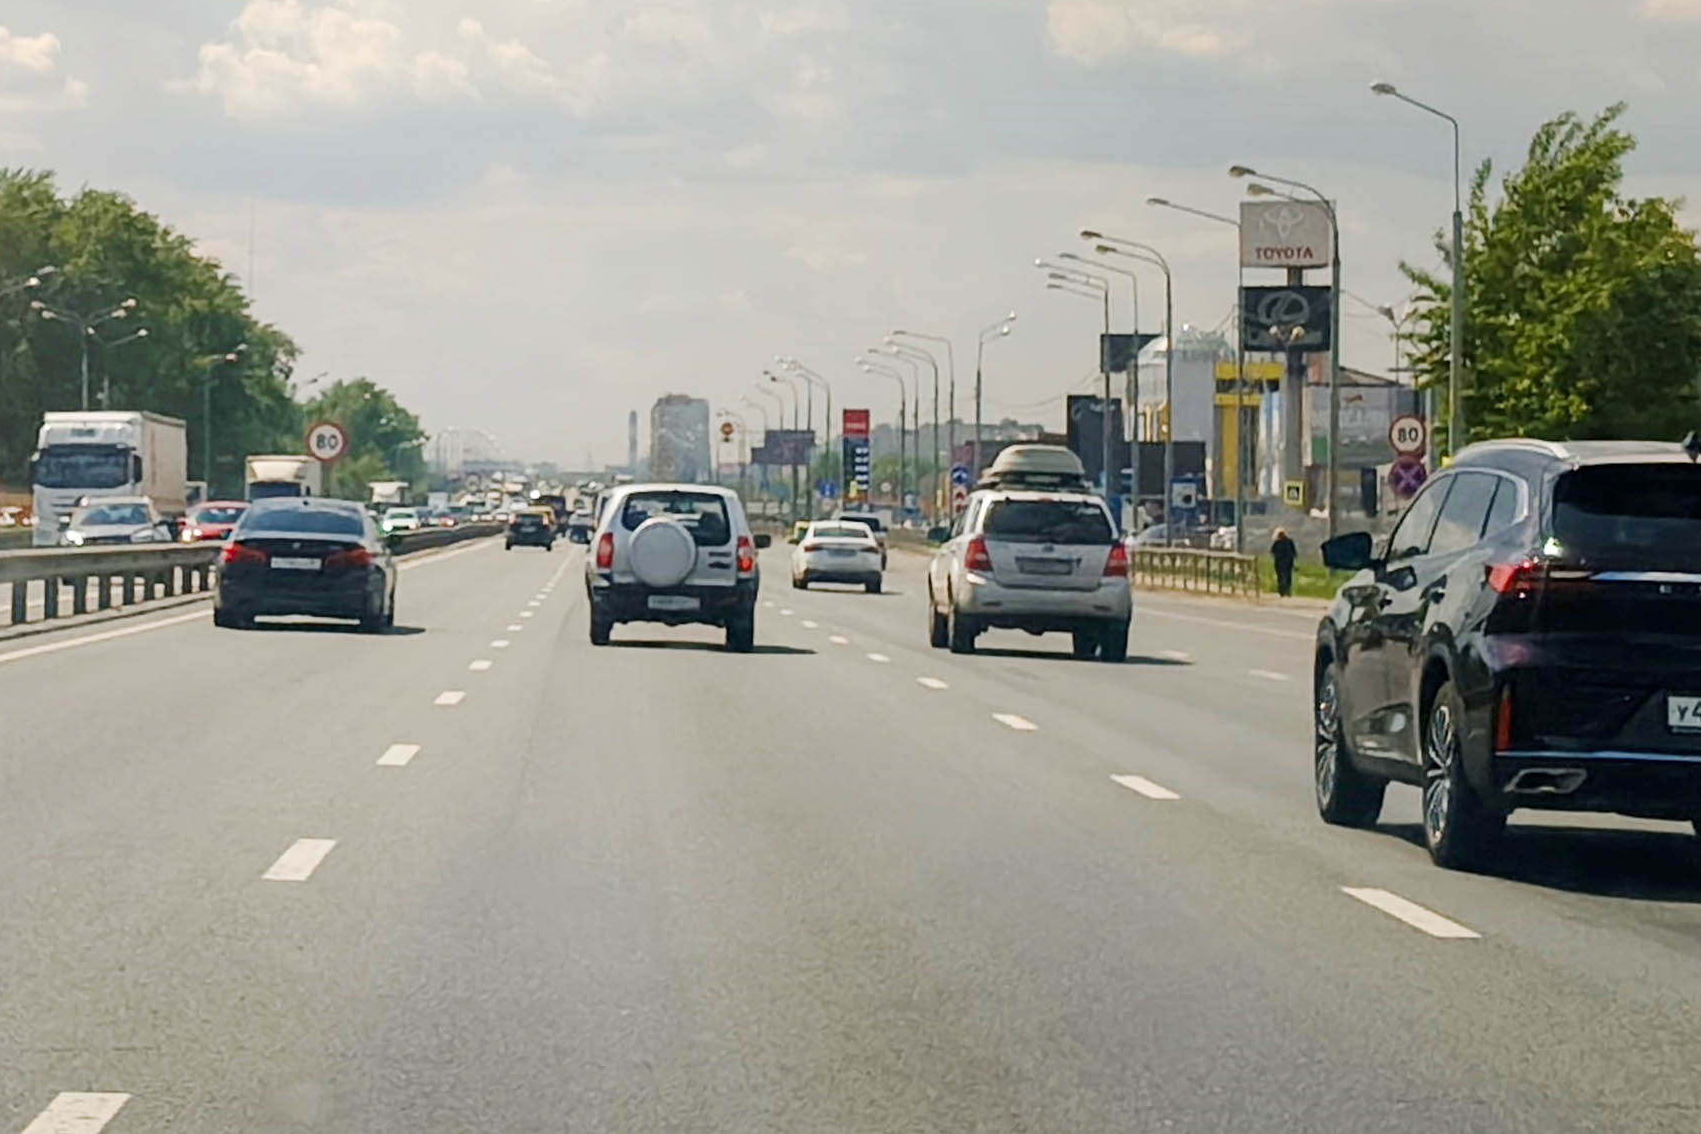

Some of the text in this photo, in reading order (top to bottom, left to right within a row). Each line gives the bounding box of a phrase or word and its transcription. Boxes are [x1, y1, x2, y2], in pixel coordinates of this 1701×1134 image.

[1255, 246, 1313, 260] TOYOTA
[316, 433, 338, 450] 80
[1398, 427, 1418, 443] 80
